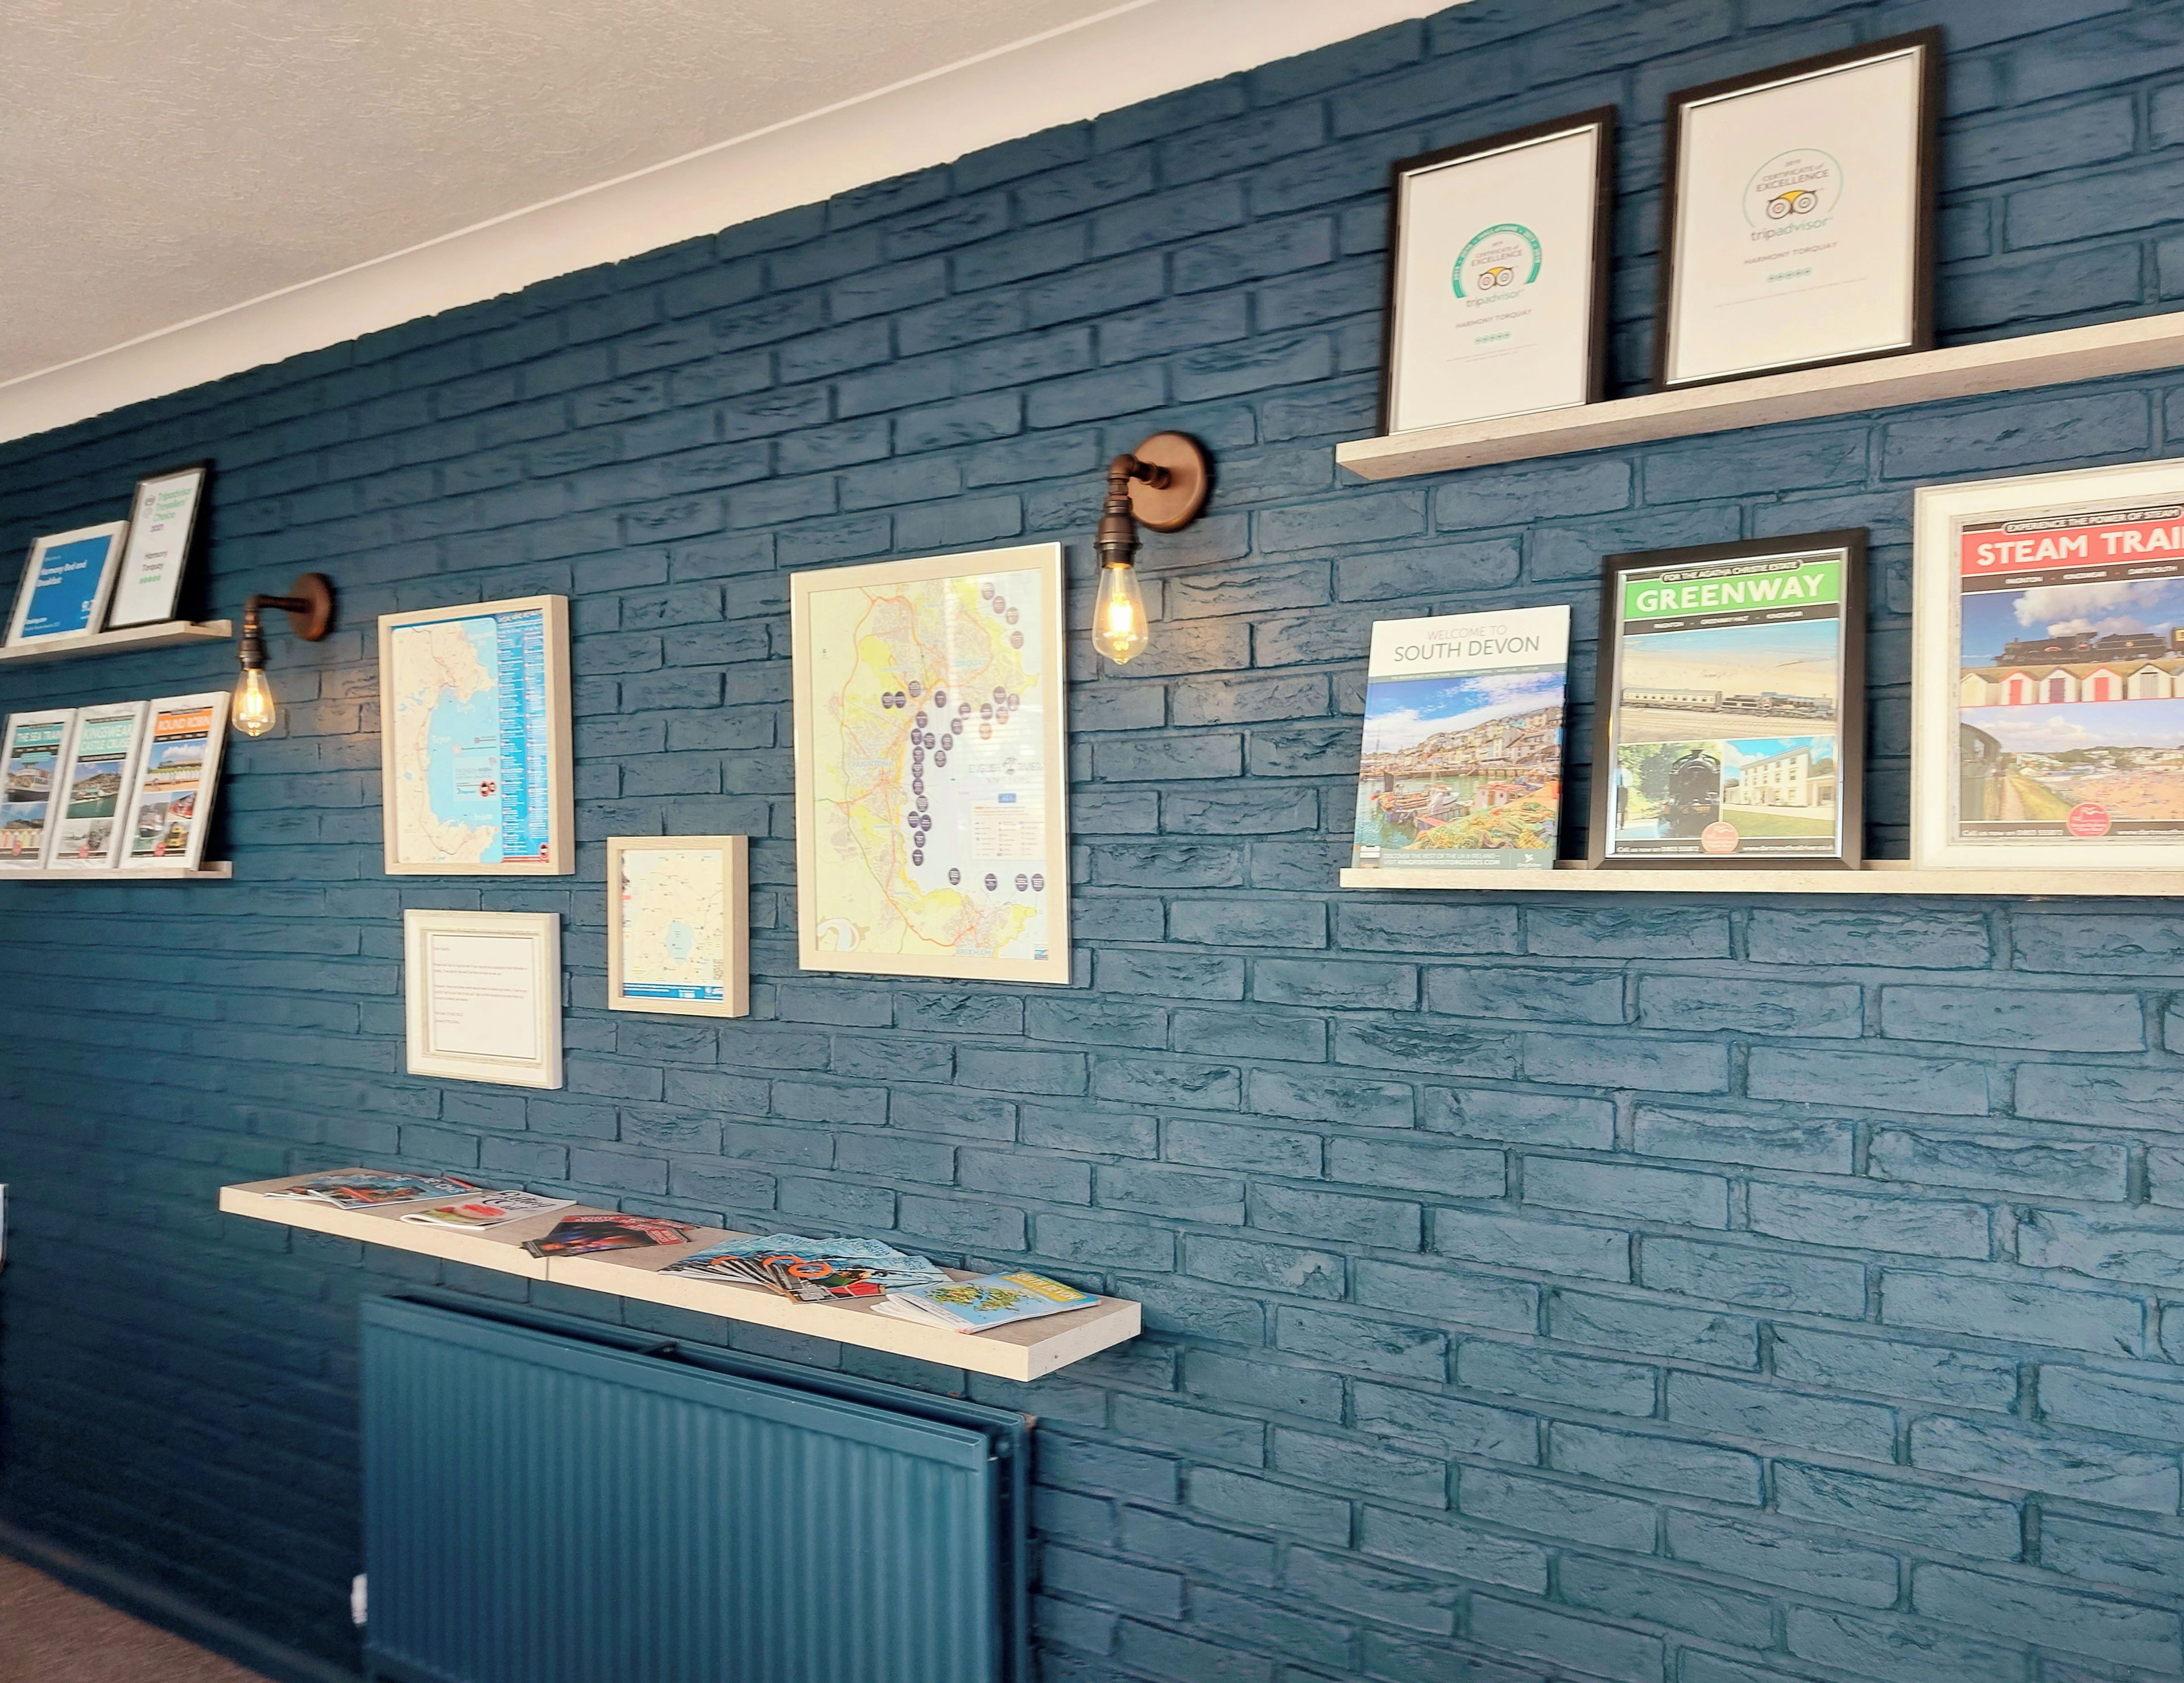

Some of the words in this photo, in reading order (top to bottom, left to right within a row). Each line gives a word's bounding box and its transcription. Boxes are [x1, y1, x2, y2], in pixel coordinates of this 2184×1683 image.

[1756, 169, 1829, 192] EXCELLENCE
[1762, 165, 1813, 181] CERTIFICATE
[1751, 219, 1827, 241] tripadvisor
[1471, 250, 1523, 266] EXCELLENCE
[1476, 246, 1511, 258] CERTIFICATE
[1744, 251, 1789, 266] HARMONY
[1793, 242, 1838, 255] TORQUAY
[1466, 291, 1519, 308] tripadvisor
[1455, 317, 1493, 328] HARMONY
[1496, 309, 1532, 320] TORQUAY
[2007, 520, 2067, 532] EXPERIENCE
[2068, 518, 2088, 526] THE
[2089, 513, 2127, 524] POWER
[2144, 508, 2179, 519] STEAM
[1977, 535, 2088, 566] STEAM
[2100, 526, 2184, 555] TRAI
[1697, 569, 1731, 578] AGATHA
[1732, 565, 1768, 574] CHRISTIE
[1768, 561, 1797, 570] ESTATE
[1636, 573, 1825, 613] GREENWAY
[1427, 626, 1486, 640] WELCOME
[1490, 625, 1507, 635] TO
[1394, 642, 1461, 661] SOUTH
[1468, 635, 1540, 656] DEVON
[1011, 1272, 1048, 1286] SOUTH
[1043, 1284, 1081, 1300] DEVON
